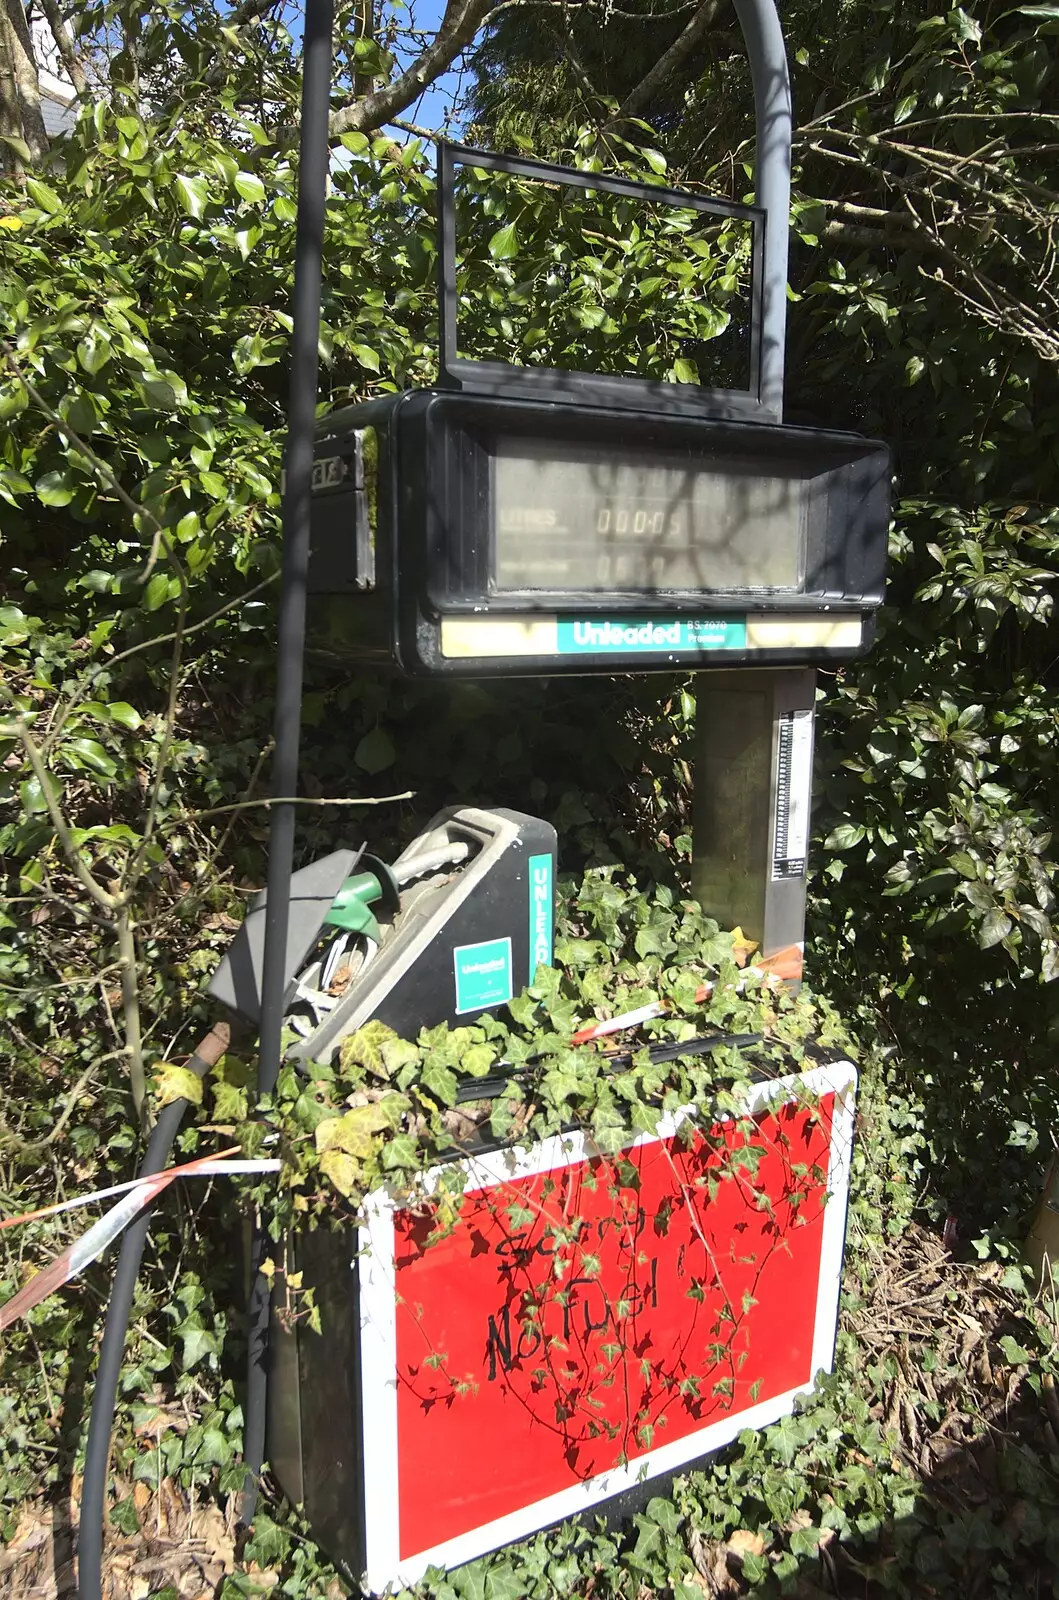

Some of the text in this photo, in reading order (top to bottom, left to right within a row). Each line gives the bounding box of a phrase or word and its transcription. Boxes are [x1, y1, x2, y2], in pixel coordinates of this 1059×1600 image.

[573, 620, 682, 646] Unleaded
[533, 867, 549, 964] UNLEAD
[487, 1304, 542, 1382] No
